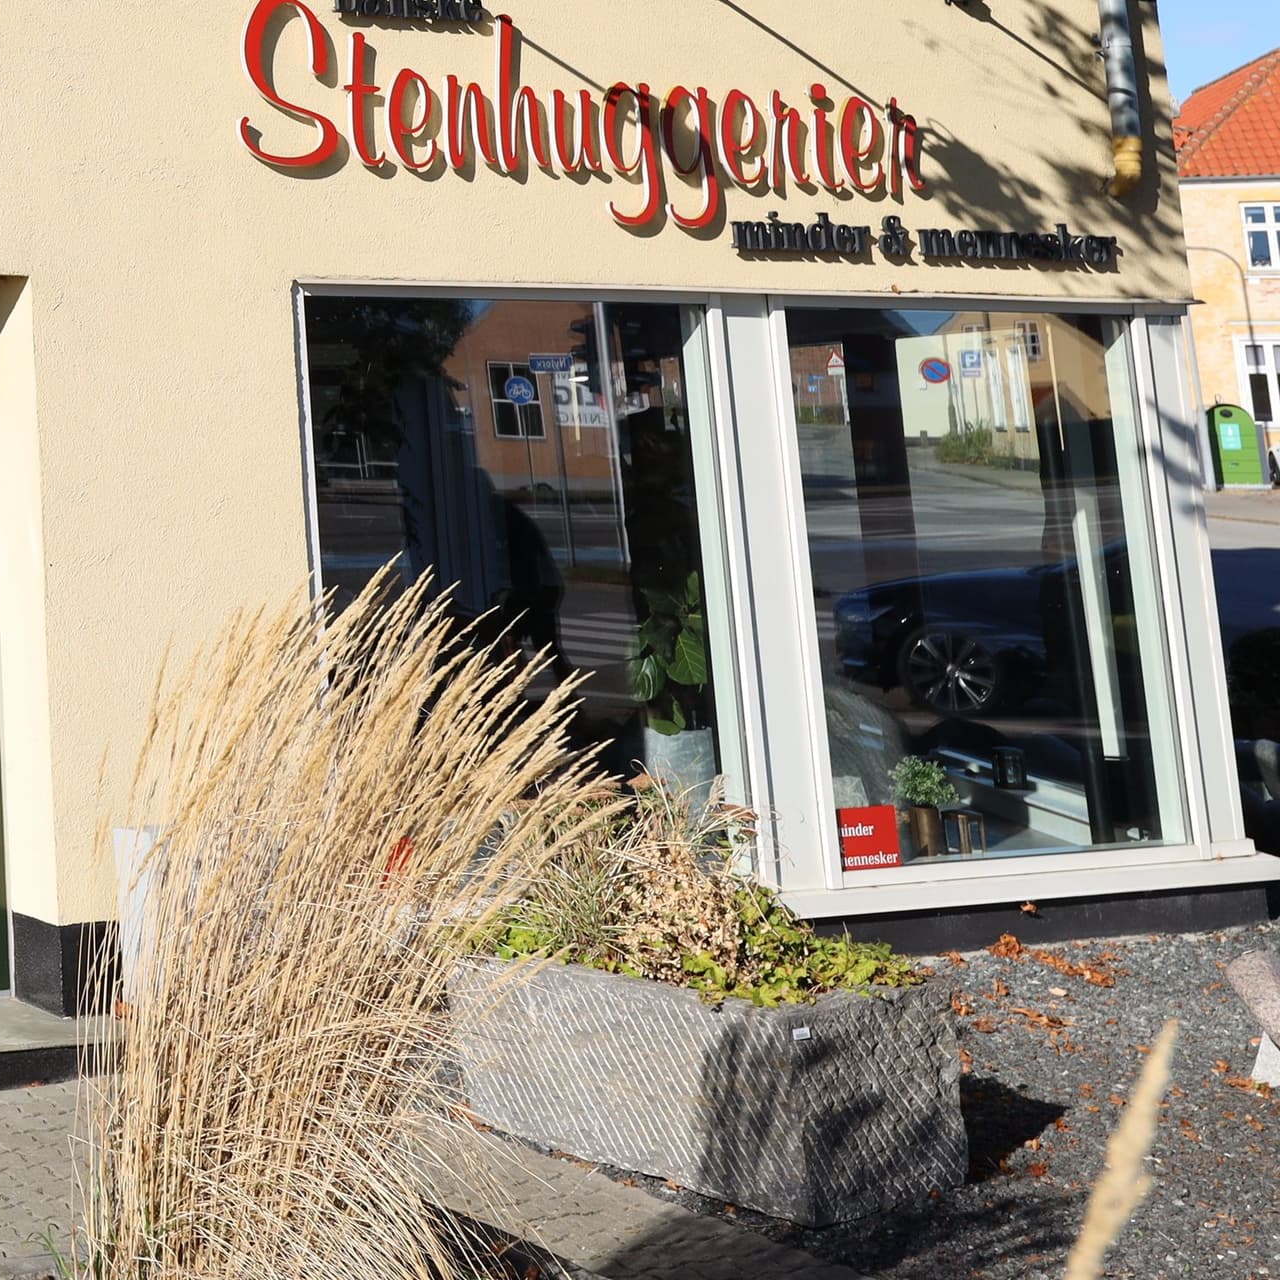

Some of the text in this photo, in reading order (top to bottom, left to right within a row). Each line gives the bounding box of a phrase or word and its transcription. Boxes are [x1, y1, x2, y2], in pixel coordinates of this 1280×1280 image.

[731, 211, 1118, 264] minder & mennesker
